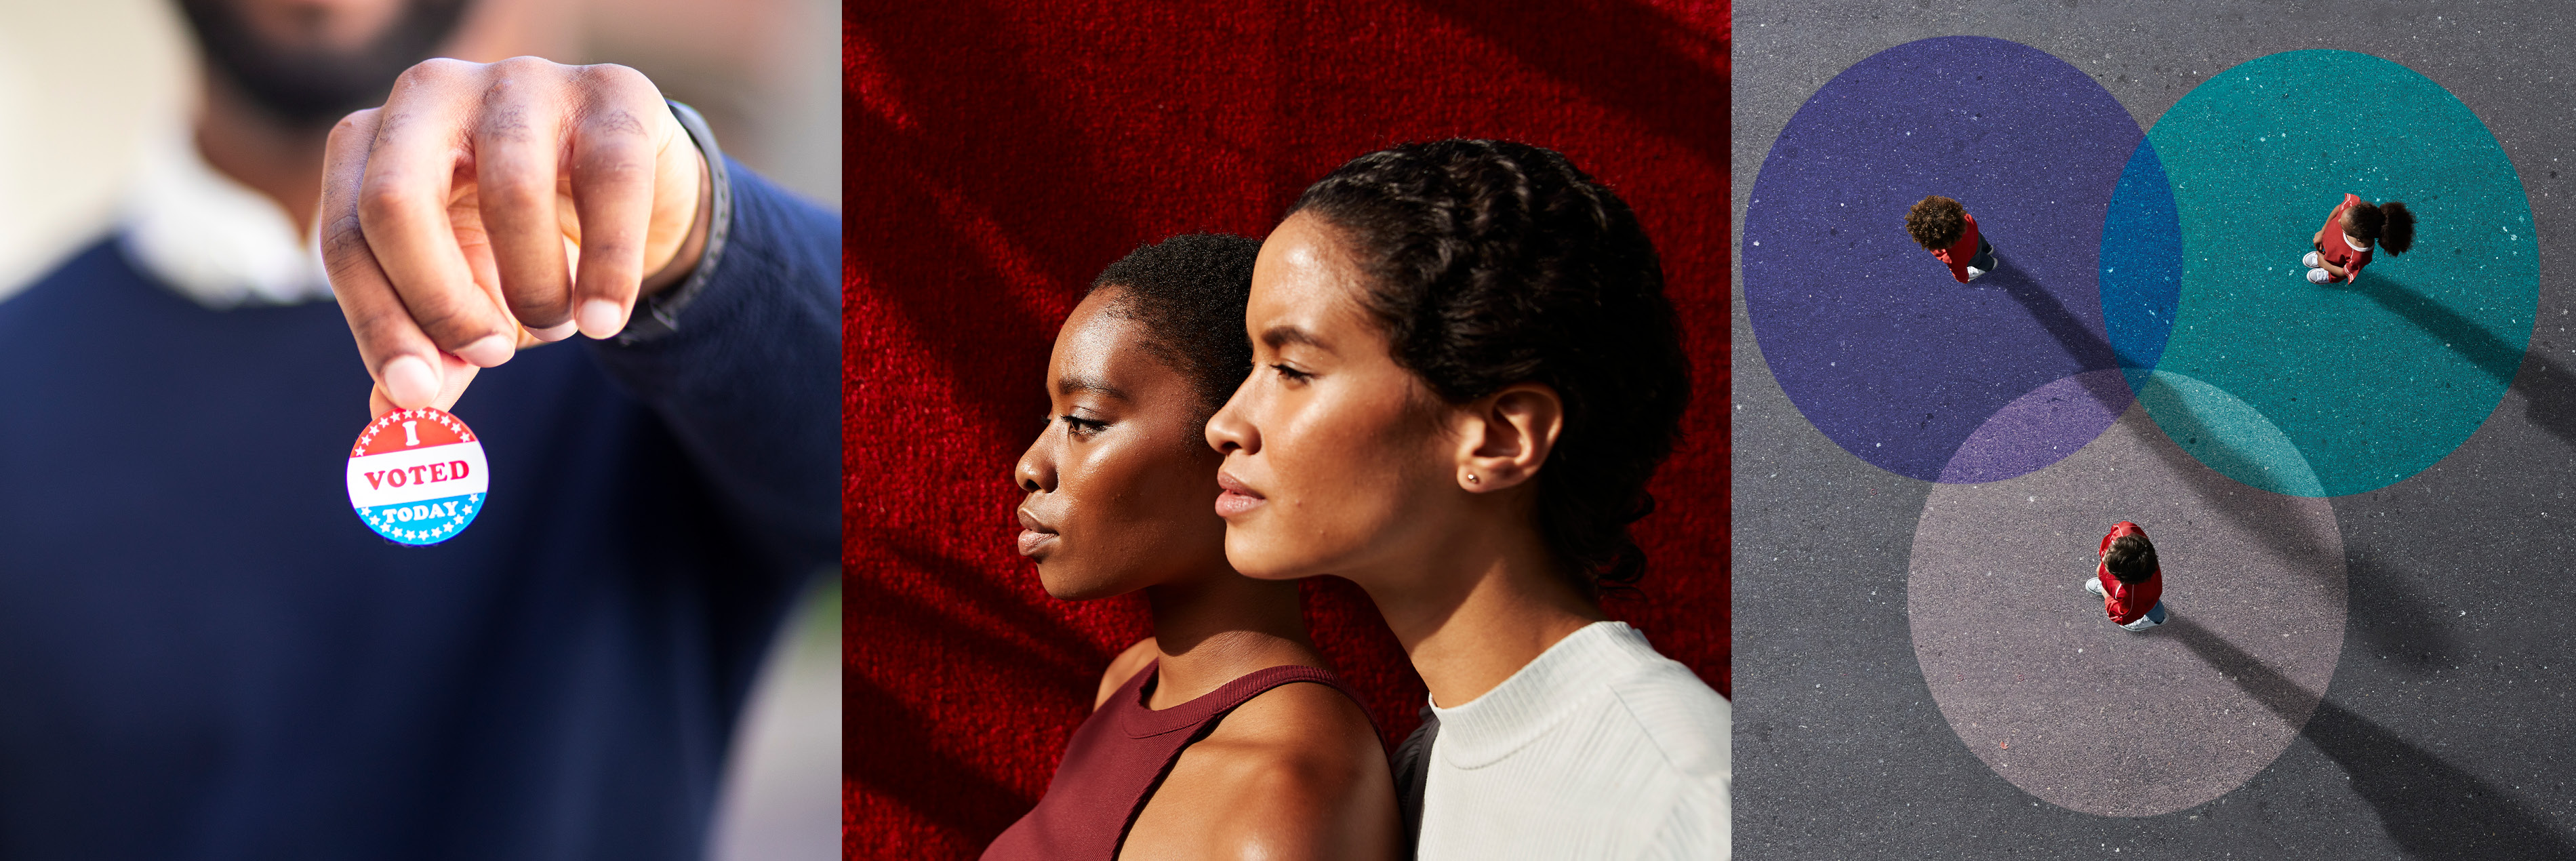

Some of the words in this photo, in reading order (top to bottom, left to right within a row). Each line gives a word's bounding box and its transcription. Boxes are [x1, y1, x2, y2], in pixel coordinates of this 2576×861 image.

[402, 420, 420, 446] I
[363, 460, 470, 490] VOTED
[382, 501, 459, 523] TODAY
